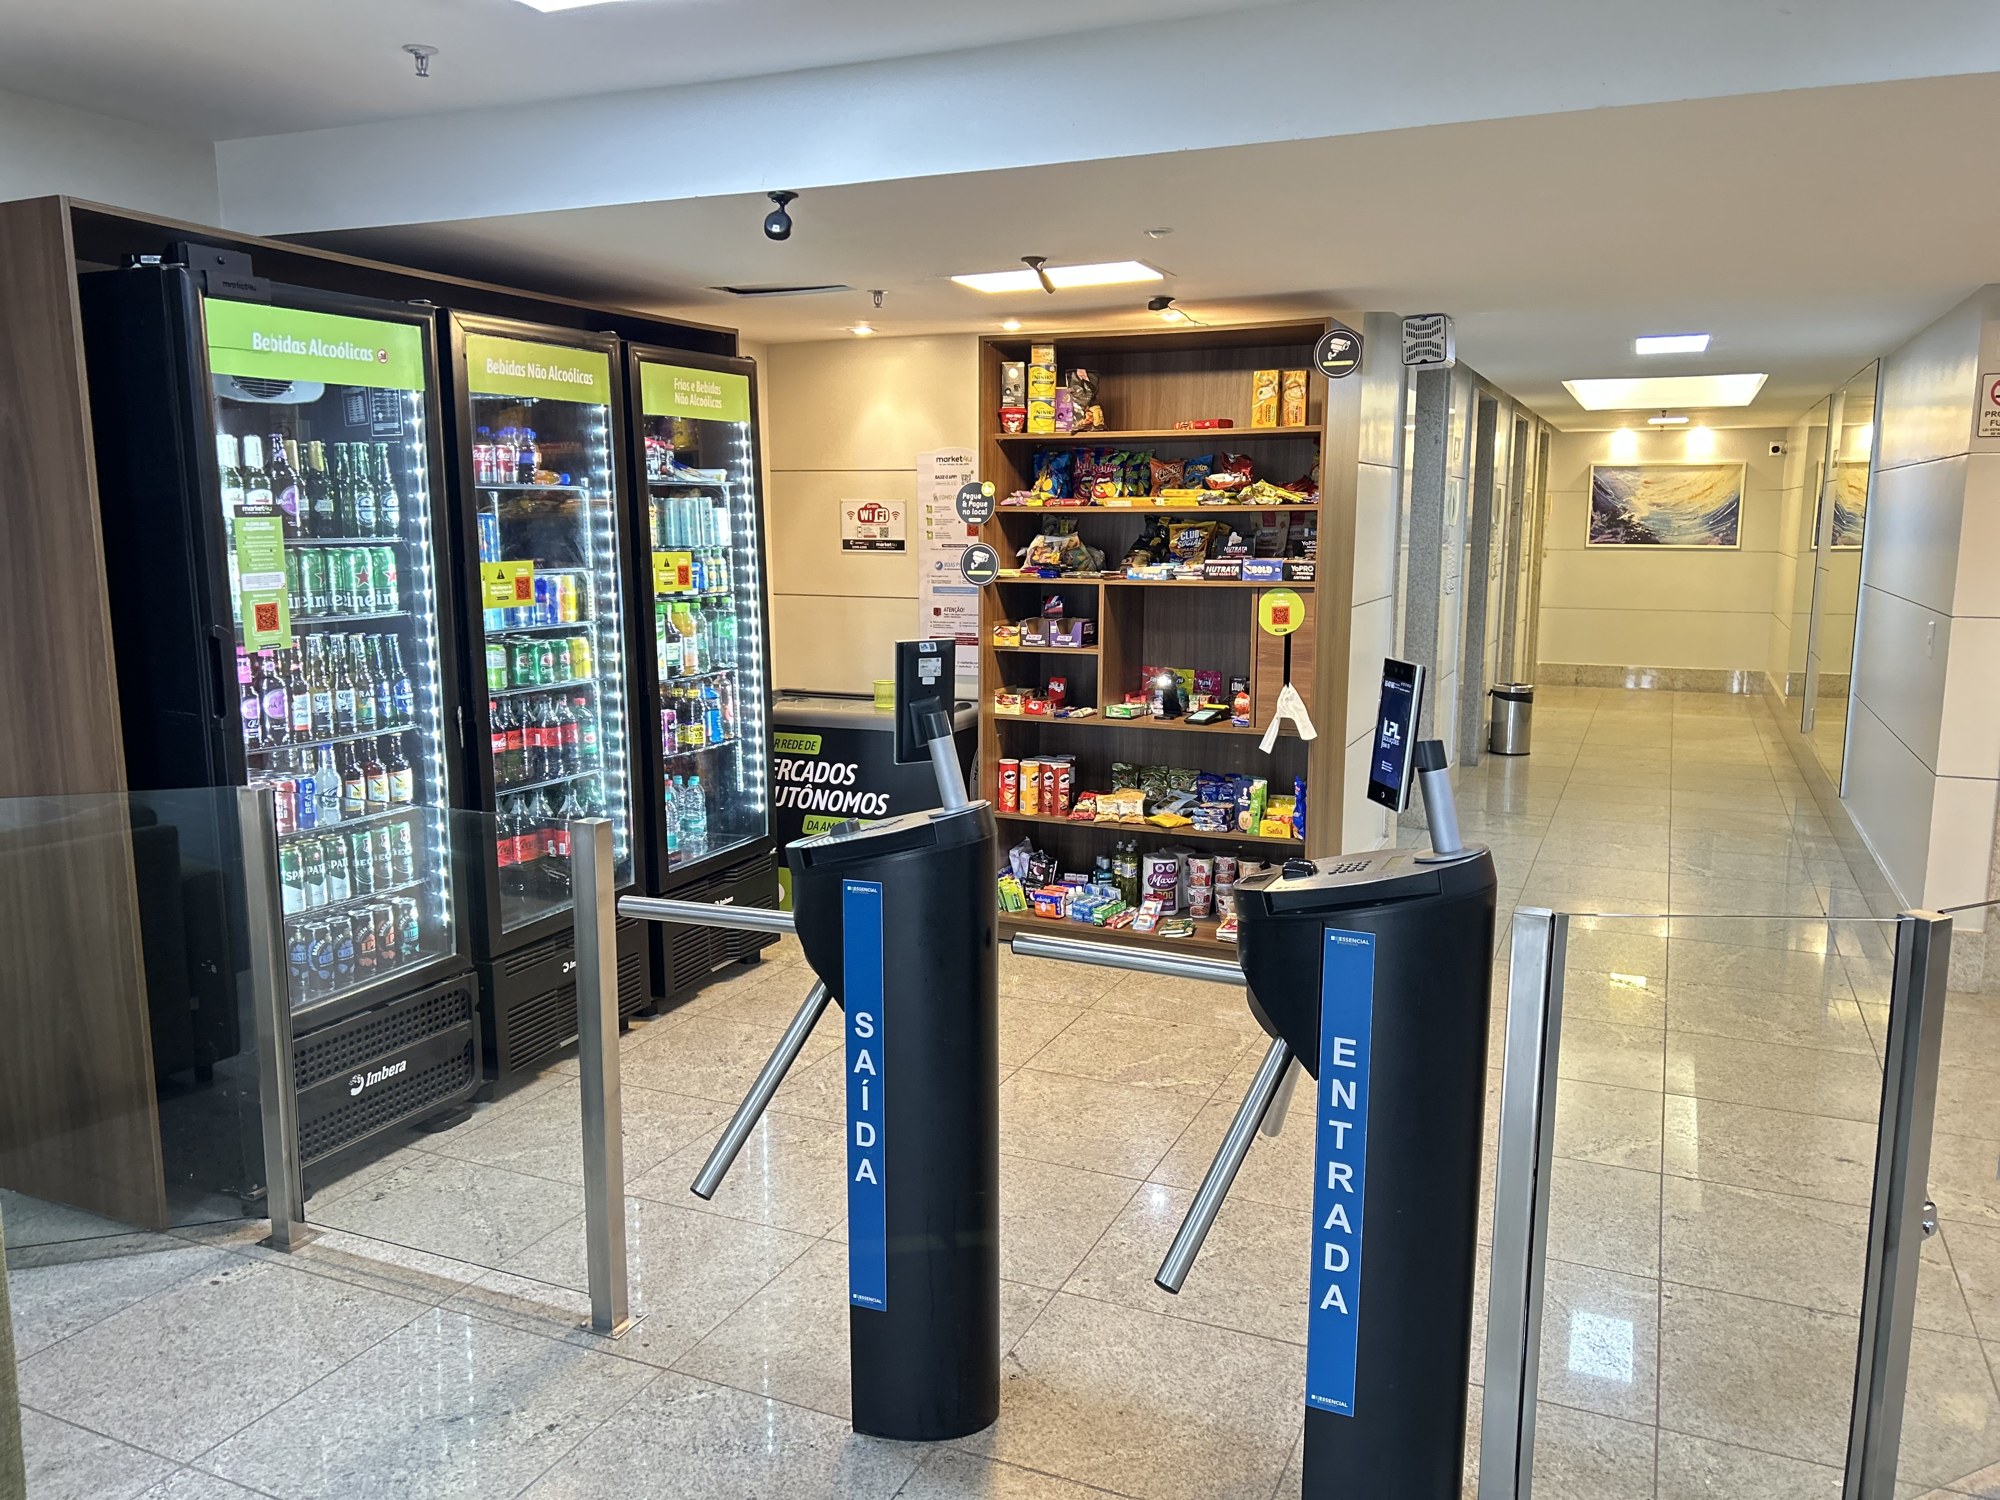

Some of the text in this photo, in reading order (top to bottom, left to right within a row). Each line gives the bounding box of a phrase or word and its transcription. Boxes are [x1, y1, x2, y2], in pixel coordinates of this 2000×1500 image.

[252, 332, 374, 362] Bebidas Alcoólicas
[486, 358, 594, 386] Bebidas Não Alcoólicas
[674, 378, 722, 396] Frios e Bebidas
[674, 392, 722, 409] Não Alcoólicas
[1180, 530, 1200, 540] CLUB
[1383, 717, 1400, 740] LPL
[781, 739, 803, 750] REDE
[804, 741, 817, 751] DE
[774, 759, 858, 786] ERCADOS
[774, 785, 890, 816] UTÔNOMOS
[807, 820, 836, 831] DA AM
[1267, 826, 1283, 835] Sadia
[1338, 936, 1370, 945] ESSENCIAL
[365, 1060, 407, 1088] Imbera
[854, 1012, 877, 1185] SAÍDA
[1320, 1036, 1357, 1315] ENTRADA
[859, 1295, 882, 1304] ESSENCIAL
[1319, 1396, 1348, 1408] ESSENCIAL
